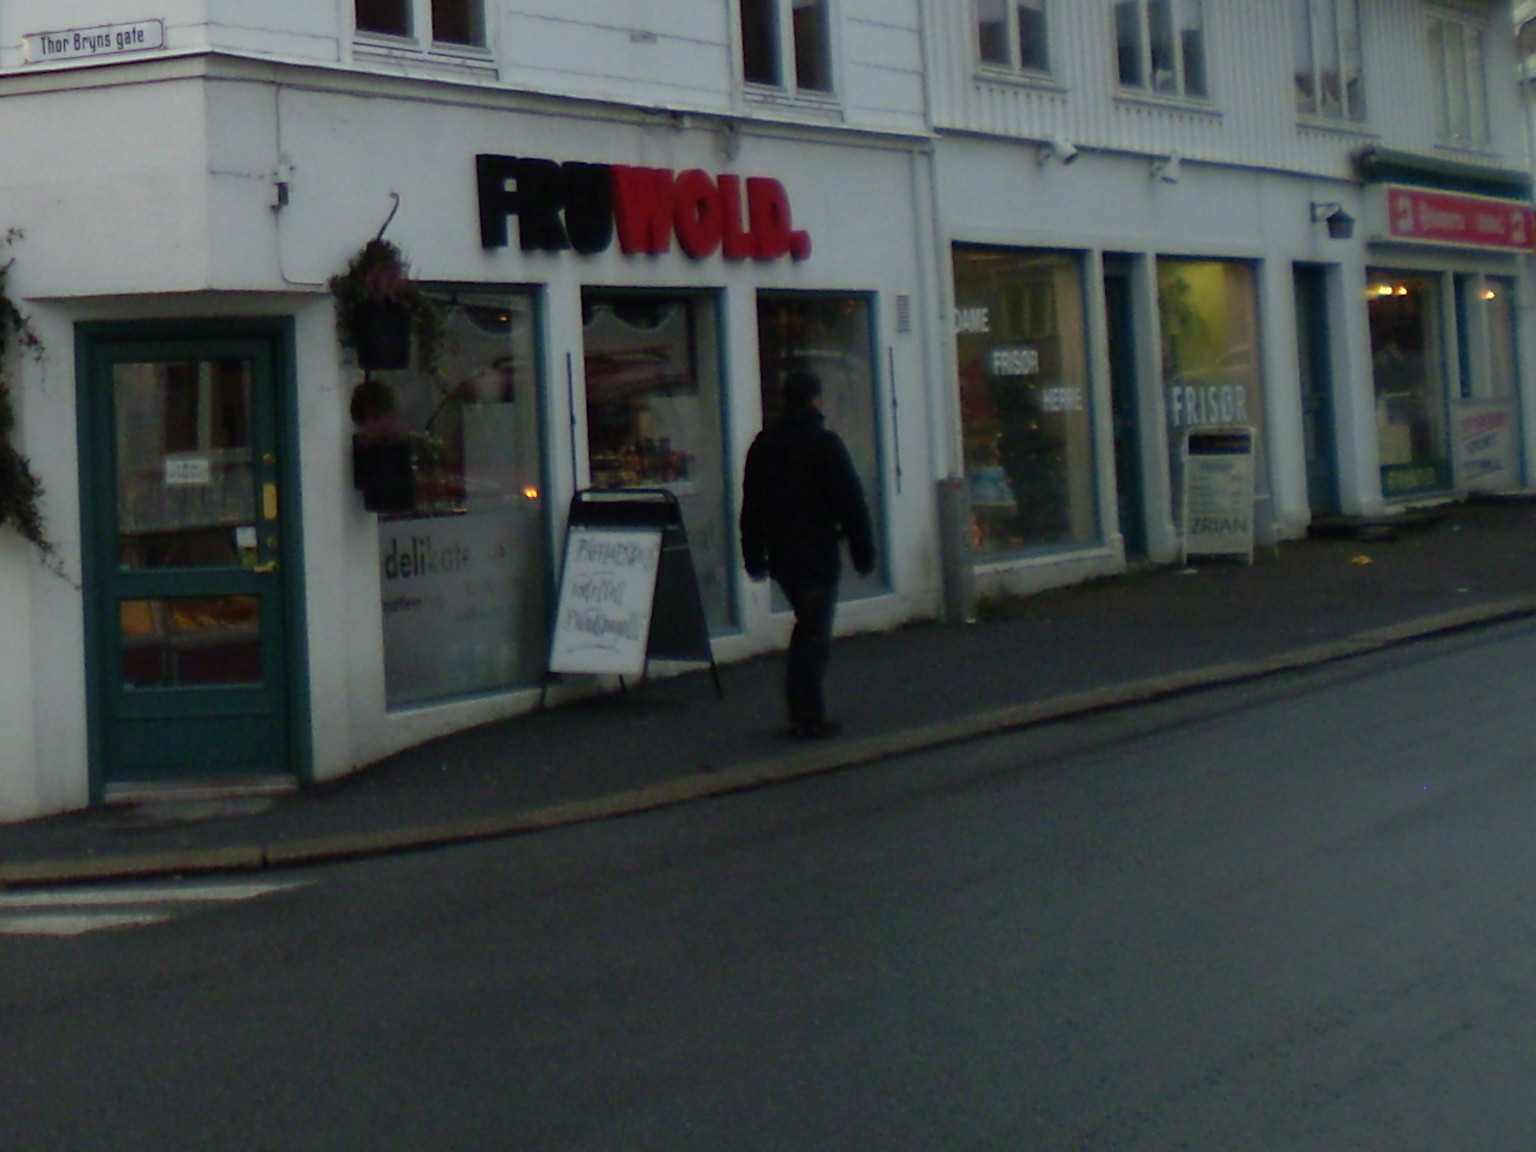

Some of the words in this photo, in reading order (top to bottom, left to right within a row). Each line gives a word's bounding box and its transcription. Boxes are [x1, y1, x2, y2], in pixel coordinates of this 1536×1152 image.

[40, 35, 70, 55] Thor
[73, 32, 111, 52] Bryns
[116, 26, 144, 49] gate
[476, 154, 613, 255] FRU
[1171, 384, 1248, 426] FRISØR
